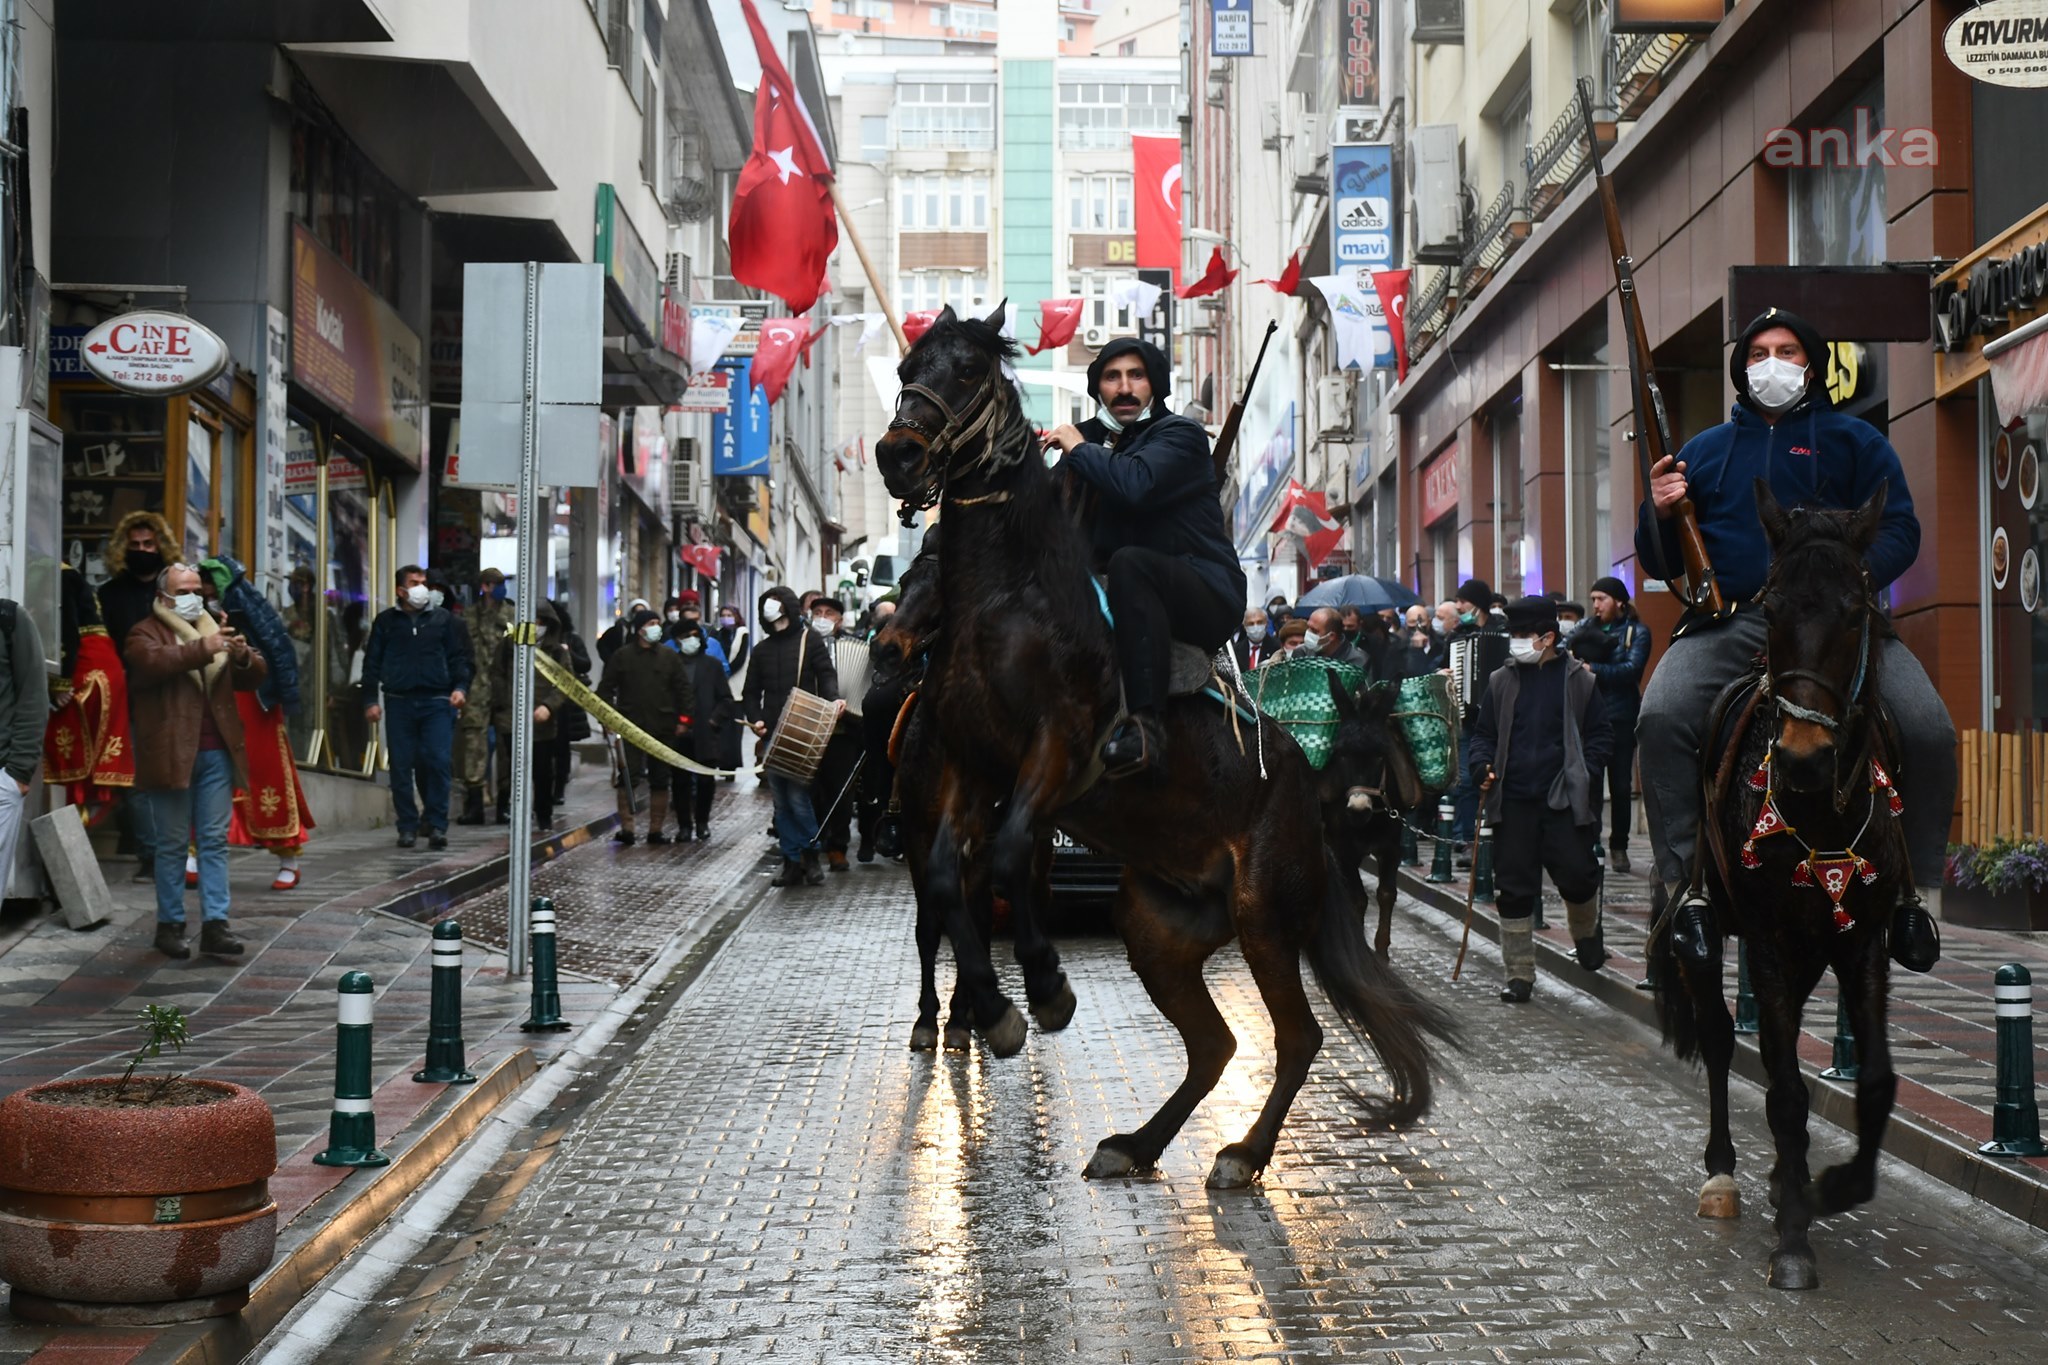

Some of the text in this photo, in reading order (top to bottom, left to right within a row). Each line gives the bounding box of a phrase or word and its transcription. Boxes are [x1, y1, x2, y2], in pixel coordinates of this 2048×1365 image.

[1217, 14, 1247, 23] HARİTA
[1967, 51, 1999, 62] LEZZETİN
[2001, 51, 2038, 61] DAMAKLA
[1342, 217, 1384, 228] adidas
[1343, 239, 1386, 255] mavi
[316, 294, 345, 352] Kodak
[112, 371, 131, 380] Tel:
[134, 372, 152, 381] 212
